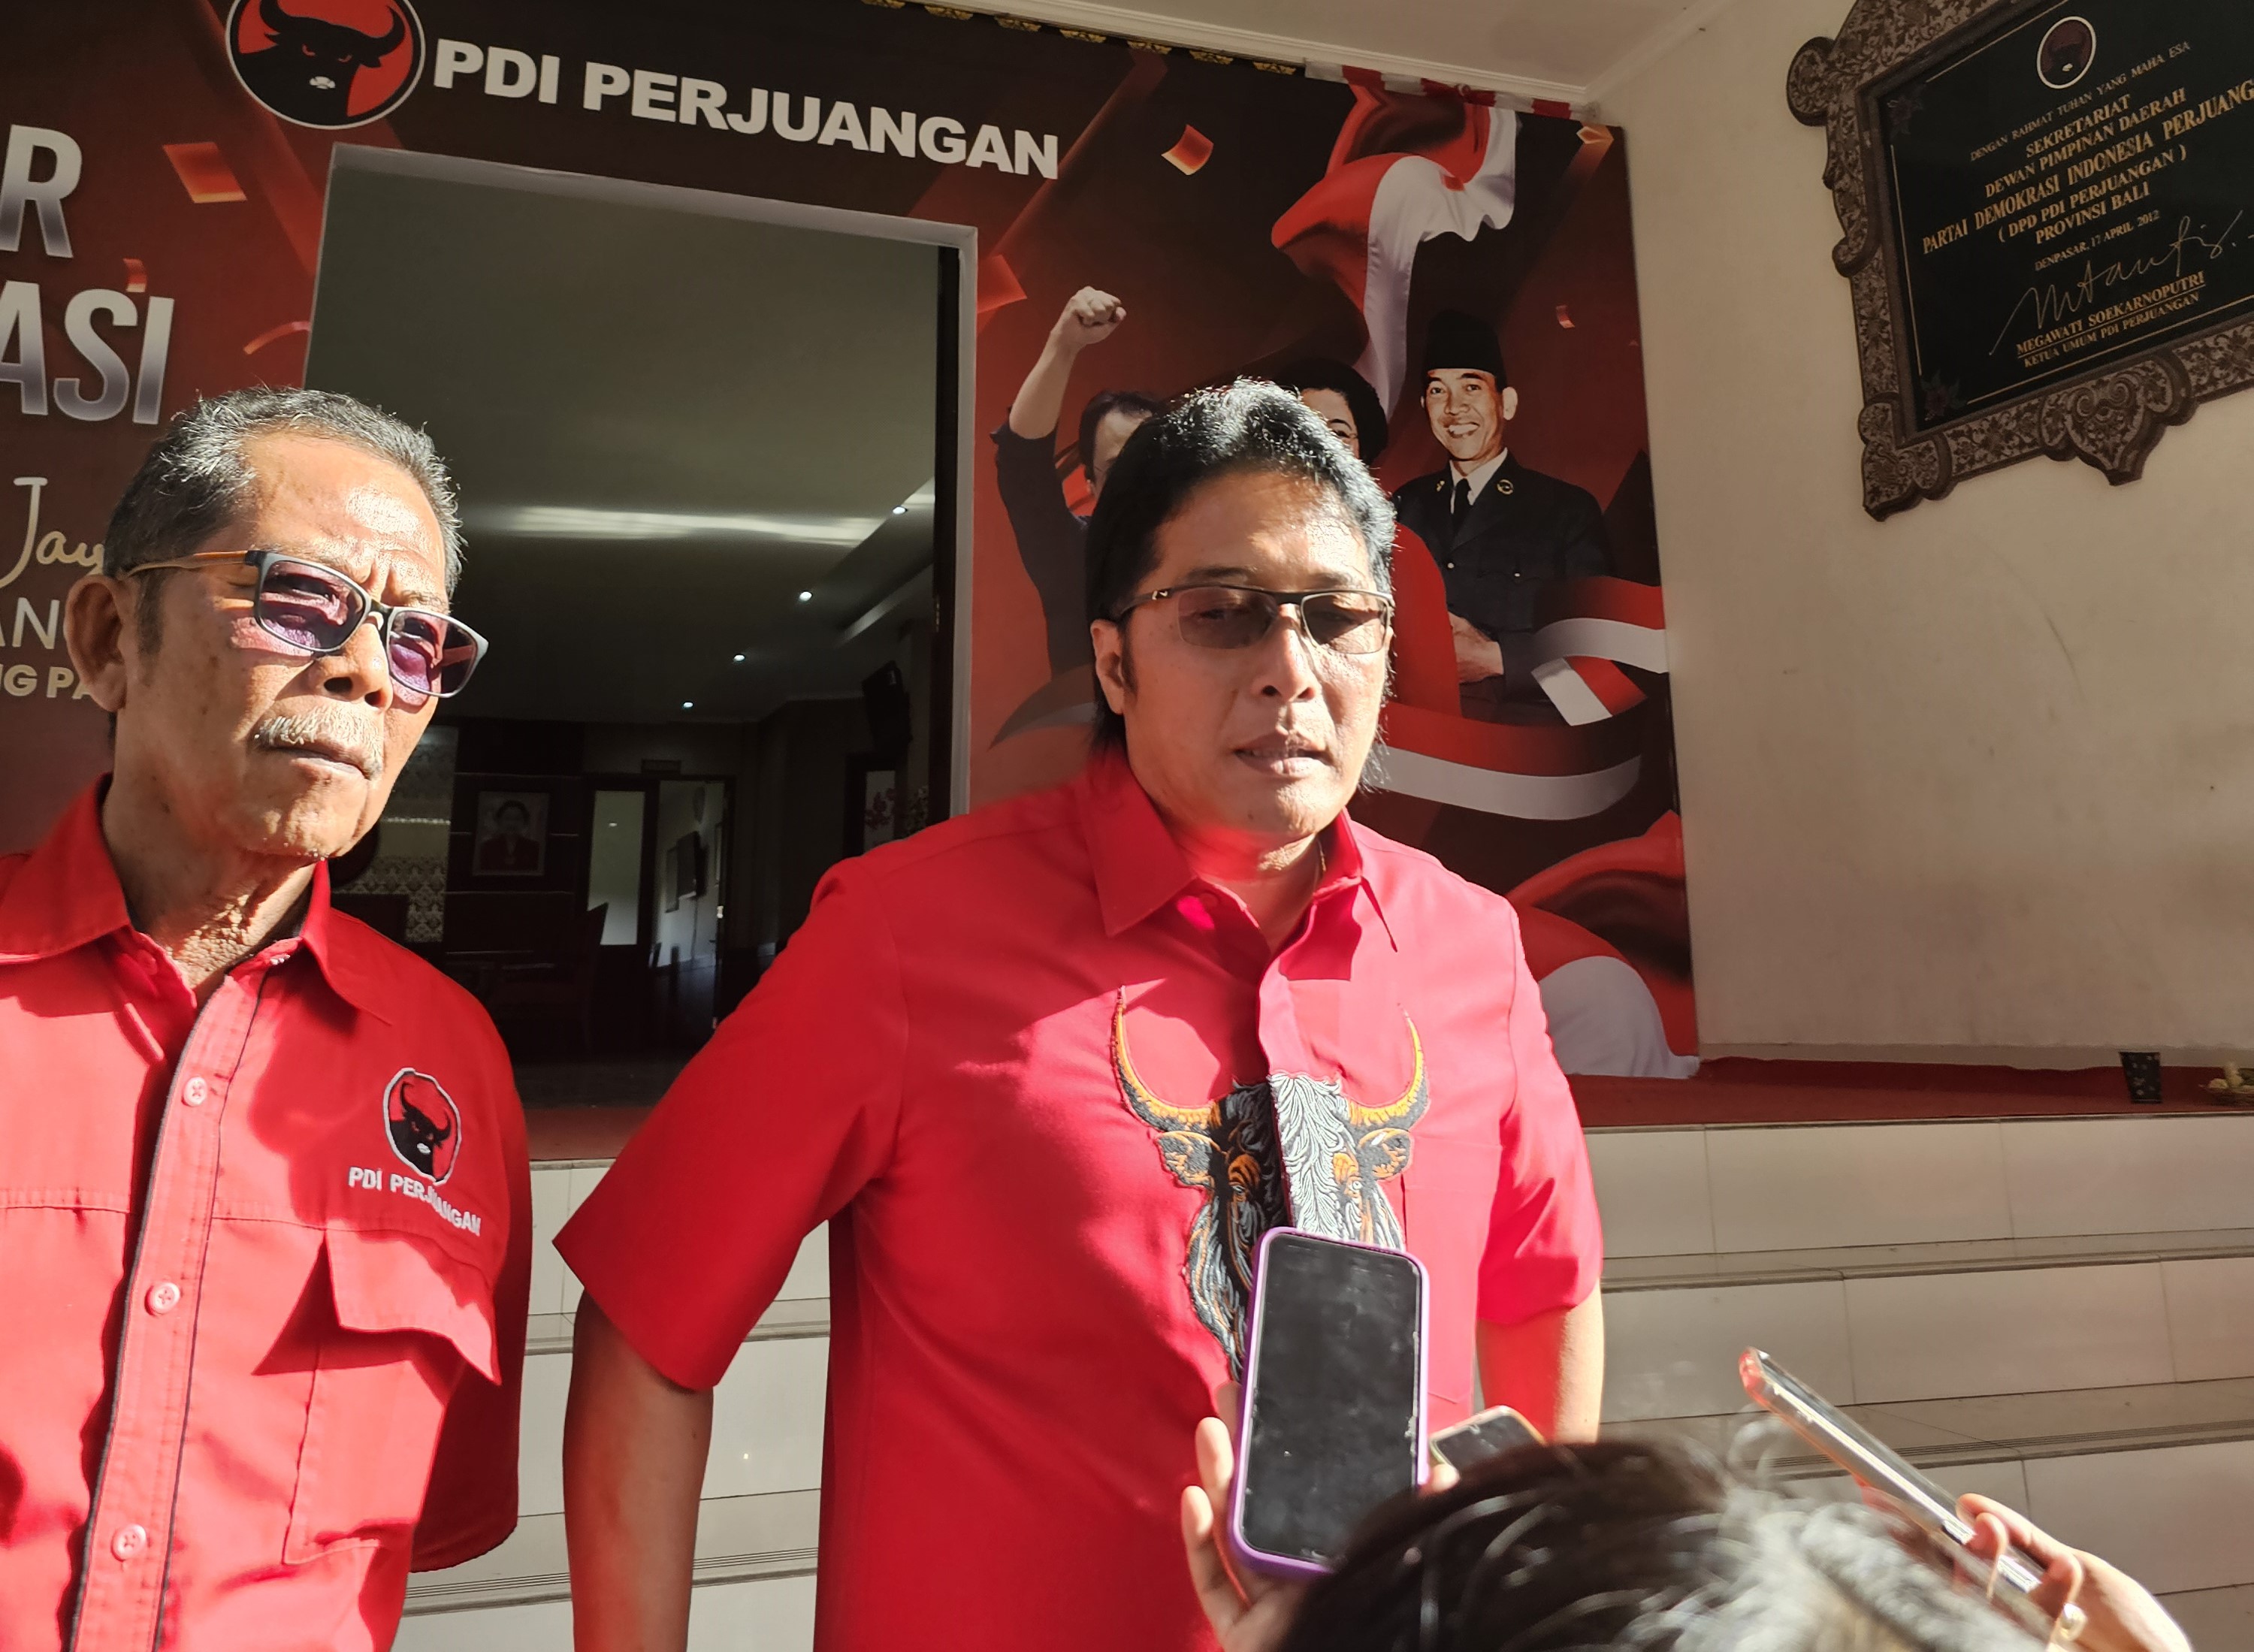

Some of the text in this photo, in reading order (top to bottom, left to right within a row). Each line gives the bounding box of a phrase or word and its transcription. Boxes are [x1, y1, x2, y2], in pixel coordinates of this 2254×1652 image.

[433, 38, 1059, 180] PDI PERJUANGAN
[1970, 41, 2191, 162] DENGAN RAHMAT TUHAN YANG MAHA ESA
[2026, 93, 2131, 158] SEKRETARIAT
[1923, 79, 2254, 255] PARTAI DEMOKRASI INDONESIA PERJUANG
[1984, 87, 2186, 198] DEWAN PIMPINAN DAERAH
[2035, 181, 2151, 245] PROVINSI BALI
[2041, 199, 2066, 222] PDI
[2091, 234, 2101, 247] 17
[2104, 222, 2134, 241] APRIL
[2137, 210, 2161, 227] 2012
[2016, 270, 2206, 355] MEGAWATI SOEKARNOPUTRI
[2023, 291, 2200, 368] KETUA UMUM PDI PERJUANGAN
[348, 1167, 382, 1191] PDI
